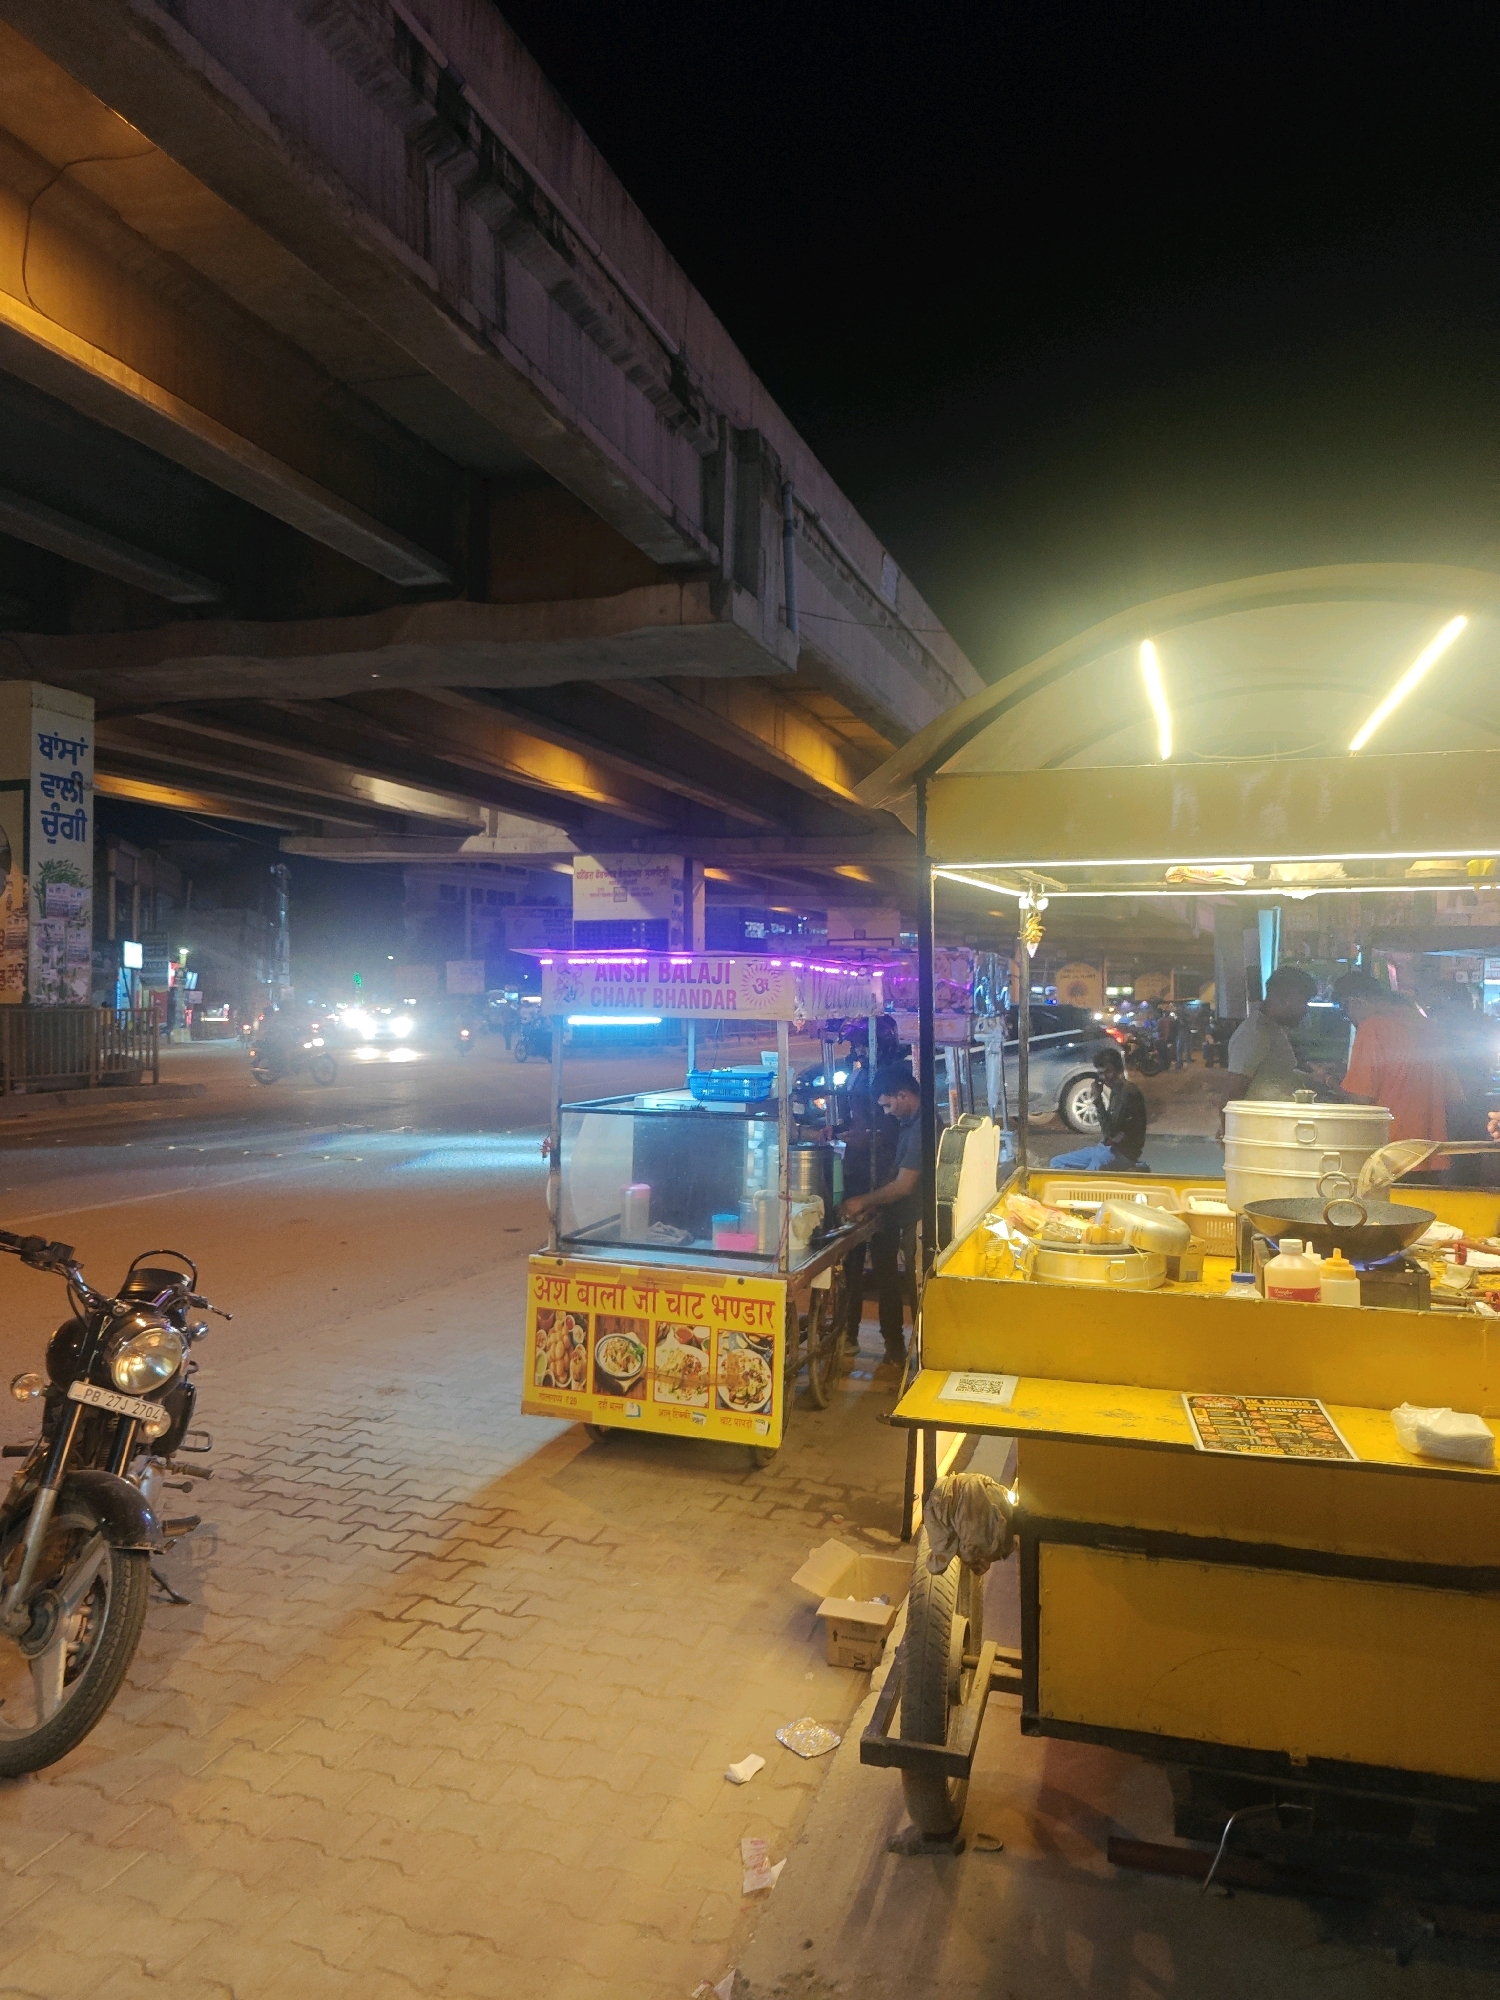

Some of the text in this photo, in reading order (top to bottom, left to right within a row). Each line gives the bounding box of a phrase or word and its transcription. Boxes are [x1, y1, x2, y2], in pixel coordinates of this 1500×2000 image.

[40, 771, 84, 804] ਵਾਲੀ
[40, 802, 88, 844] ਚੁੰਗੀ
[595, 959, 731, 985] ANSH BALAJI
[590, 985, 737, 1011] CHAAT BHANDAR
[665, 1289, 706, 1320] चाट
[711, 1294, 776, 1329] भण्डार
[83, 1388, 161, 1420] PB 27J 2704
[1263, 1399, 1311, 1407] MOMOS
